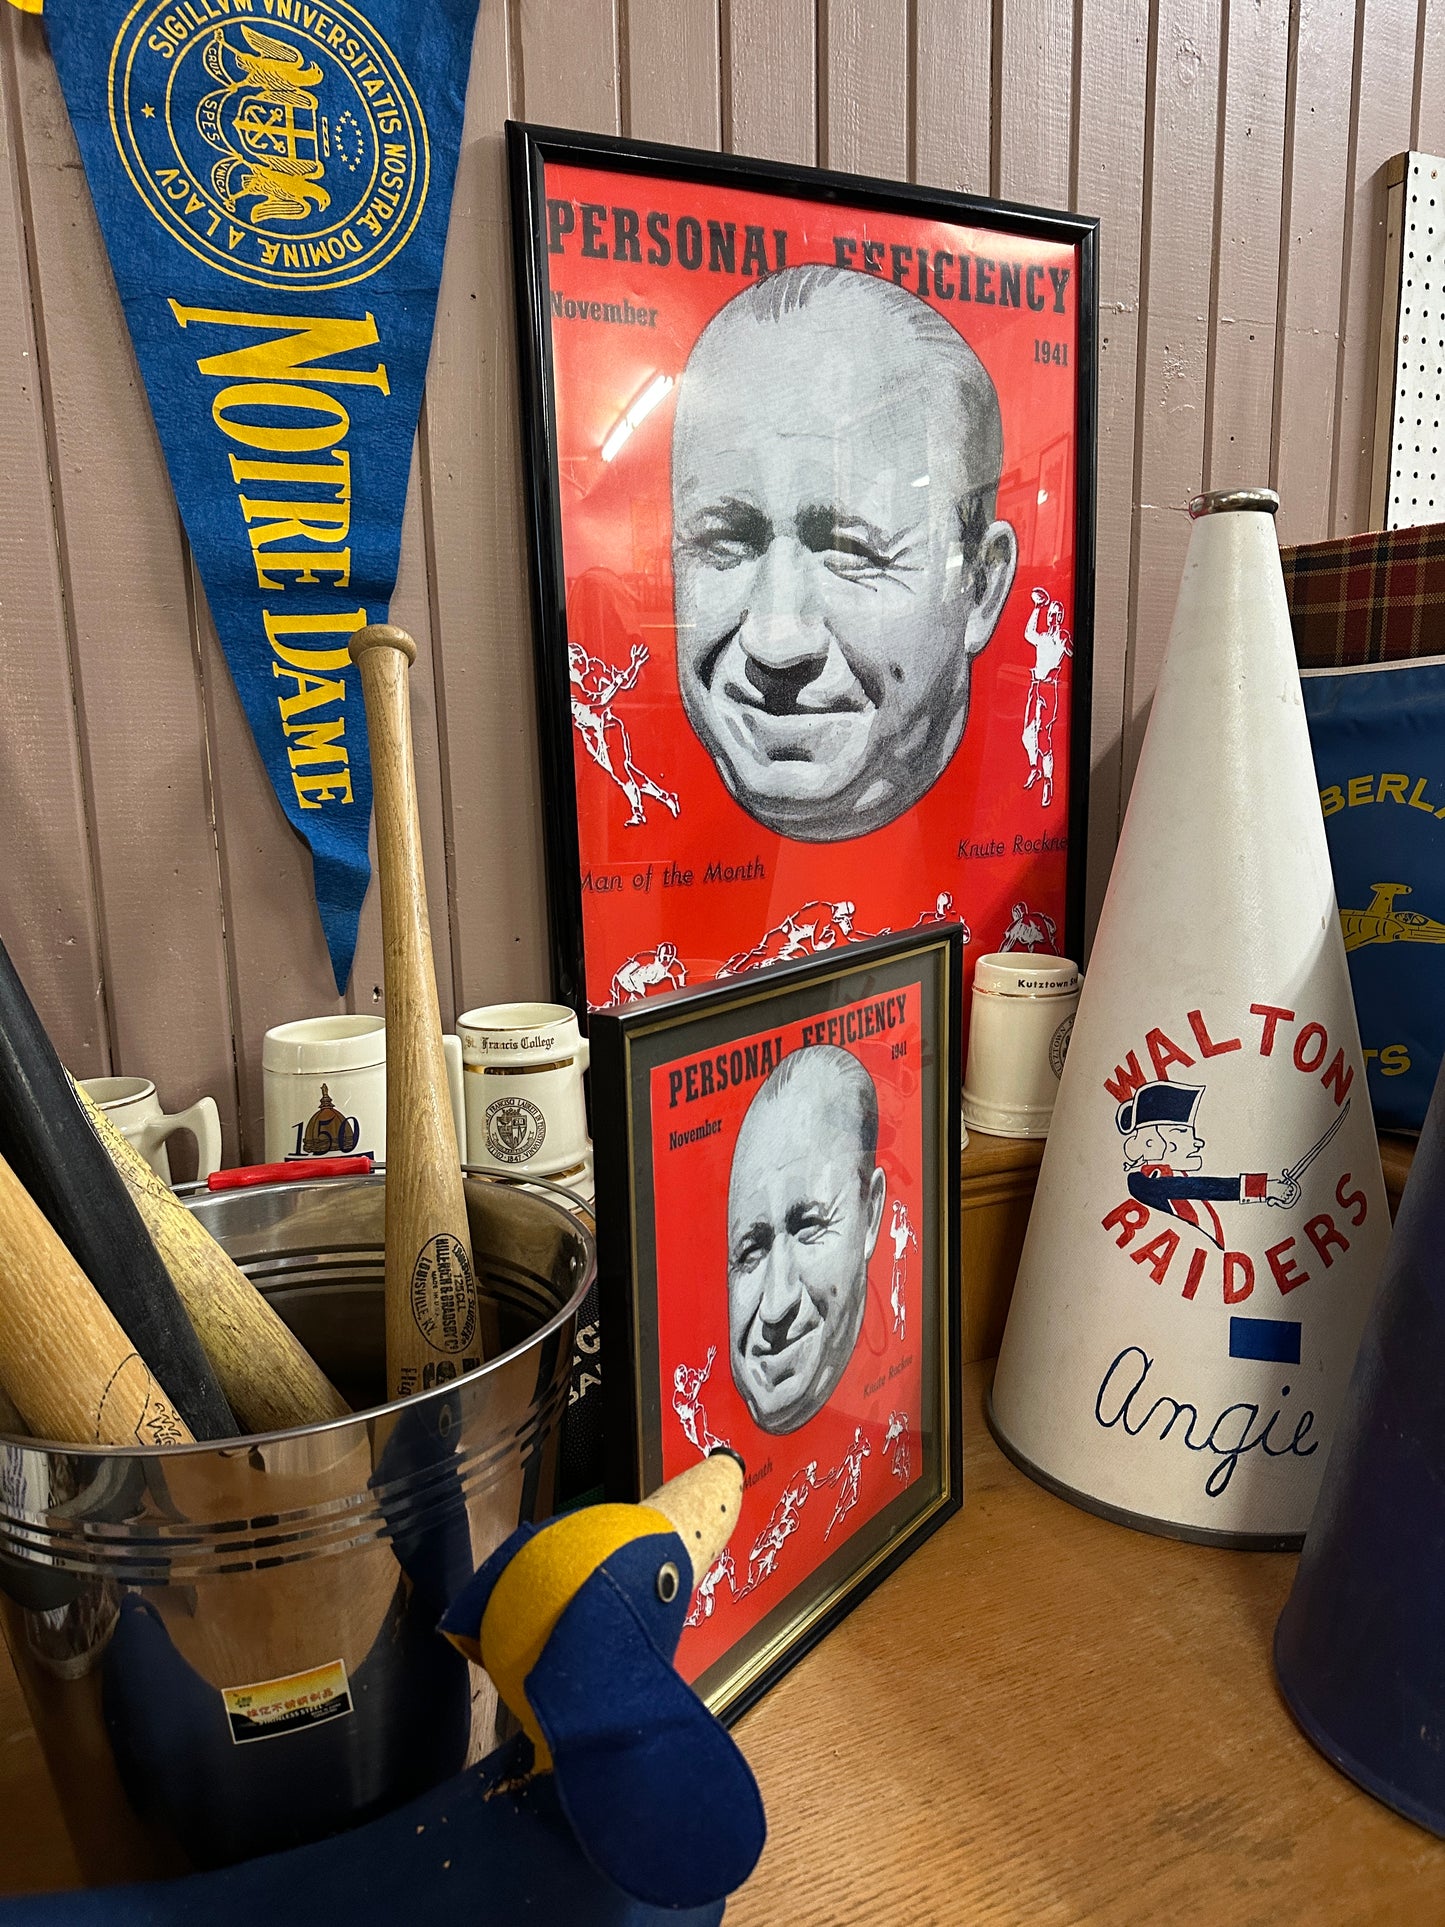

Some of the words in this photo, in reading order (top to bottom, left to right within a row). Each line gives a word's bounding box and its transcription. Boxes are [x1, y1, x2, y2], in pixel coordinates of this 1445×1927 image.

[208, 47, 223, 77] CRUX
[202, 100, 220, 141] SPES
[216, 163, 231, 193] VNICA
[550, 290, 658, 327] November
[1033, 340, 1069, 368] 1941
[167, 297, 391, 590] NOTRE
[263, 607, 368, 810] DAME
[1320, 773, 1445, 821] BERL
[957, 837, 1005, 859] Knute
[1013, 829, 1068, 855] Rockne
[633, 864, 653, 893] of
[663, 861, 694, 886] the
[704, 856, 765, 883] Month
[1018, 979, 1068, 989] Kutztown
[481, 1036, 519, 1054] Francis
[520, 1035, 555, 1050] College
[669, 1037, 783, 1108] PERSONAL
[802, 994, 906, 1046] EFFICIENCY
[891, 1040, 907, 1060] 1941
[1052, 1026, 1067, 1073] UTZTOWN
[1104, 1004, 1355, 1107] WALTON
[288, 1116, 360, 1156] 150
[669, 1119, 722, 1151] November
[1101, 1172, 1368, 1304] RAIDERS
[1094, 1346, 1319, 1498] Angie
